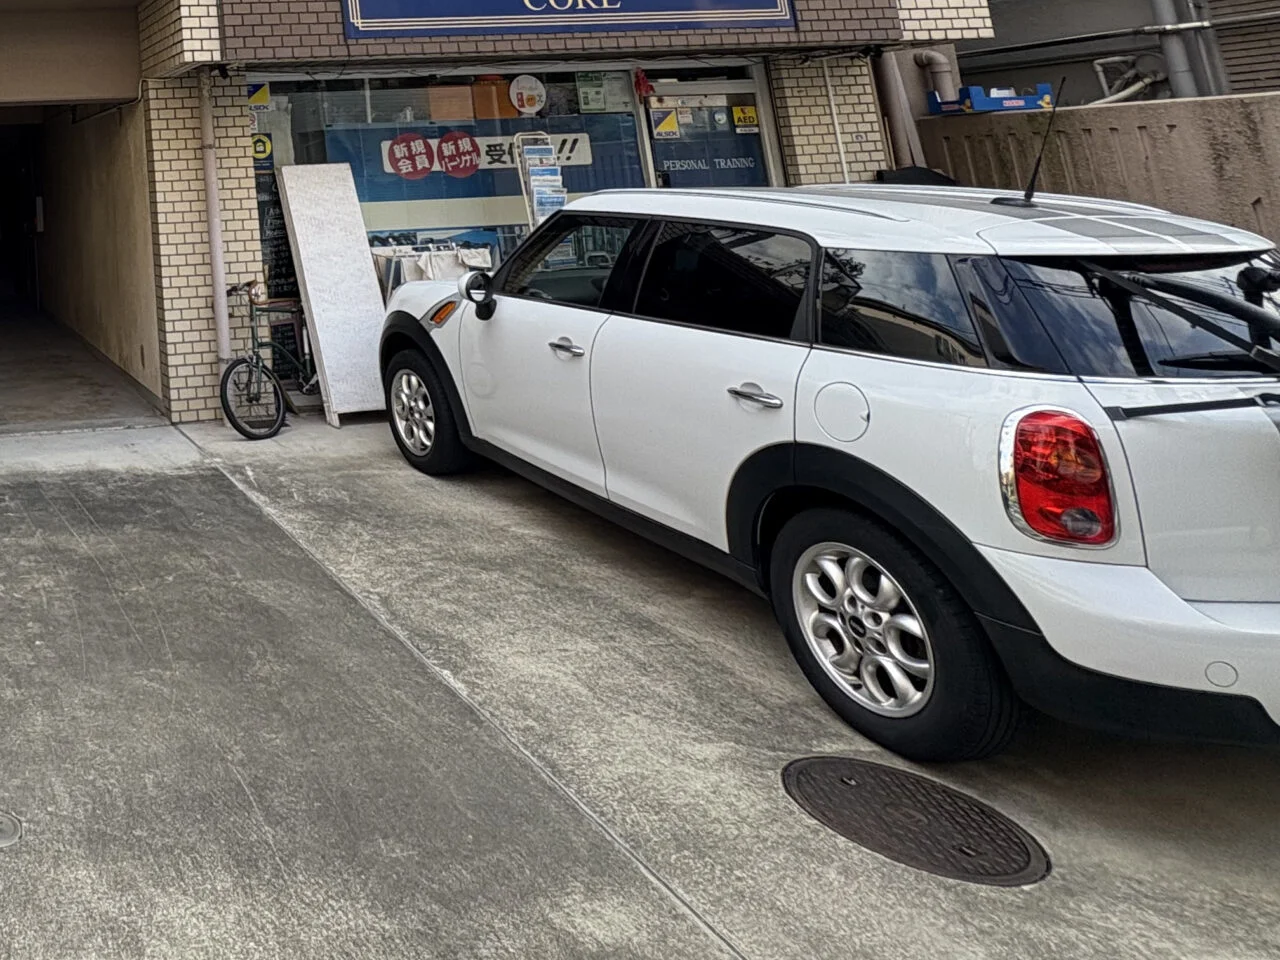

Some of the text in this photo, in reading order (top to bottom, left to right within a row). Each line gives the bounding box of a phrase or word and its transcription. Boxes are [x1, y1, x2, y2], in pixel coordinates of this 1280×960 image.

[736, 115, 756, 124] AED
[392, 139, 426, 159] 新規
[441, 137, 474, 157] 新規
[397, 154, 431, 174] 会員
[662, 157, 756, 171] PERSONAL TRAINING
